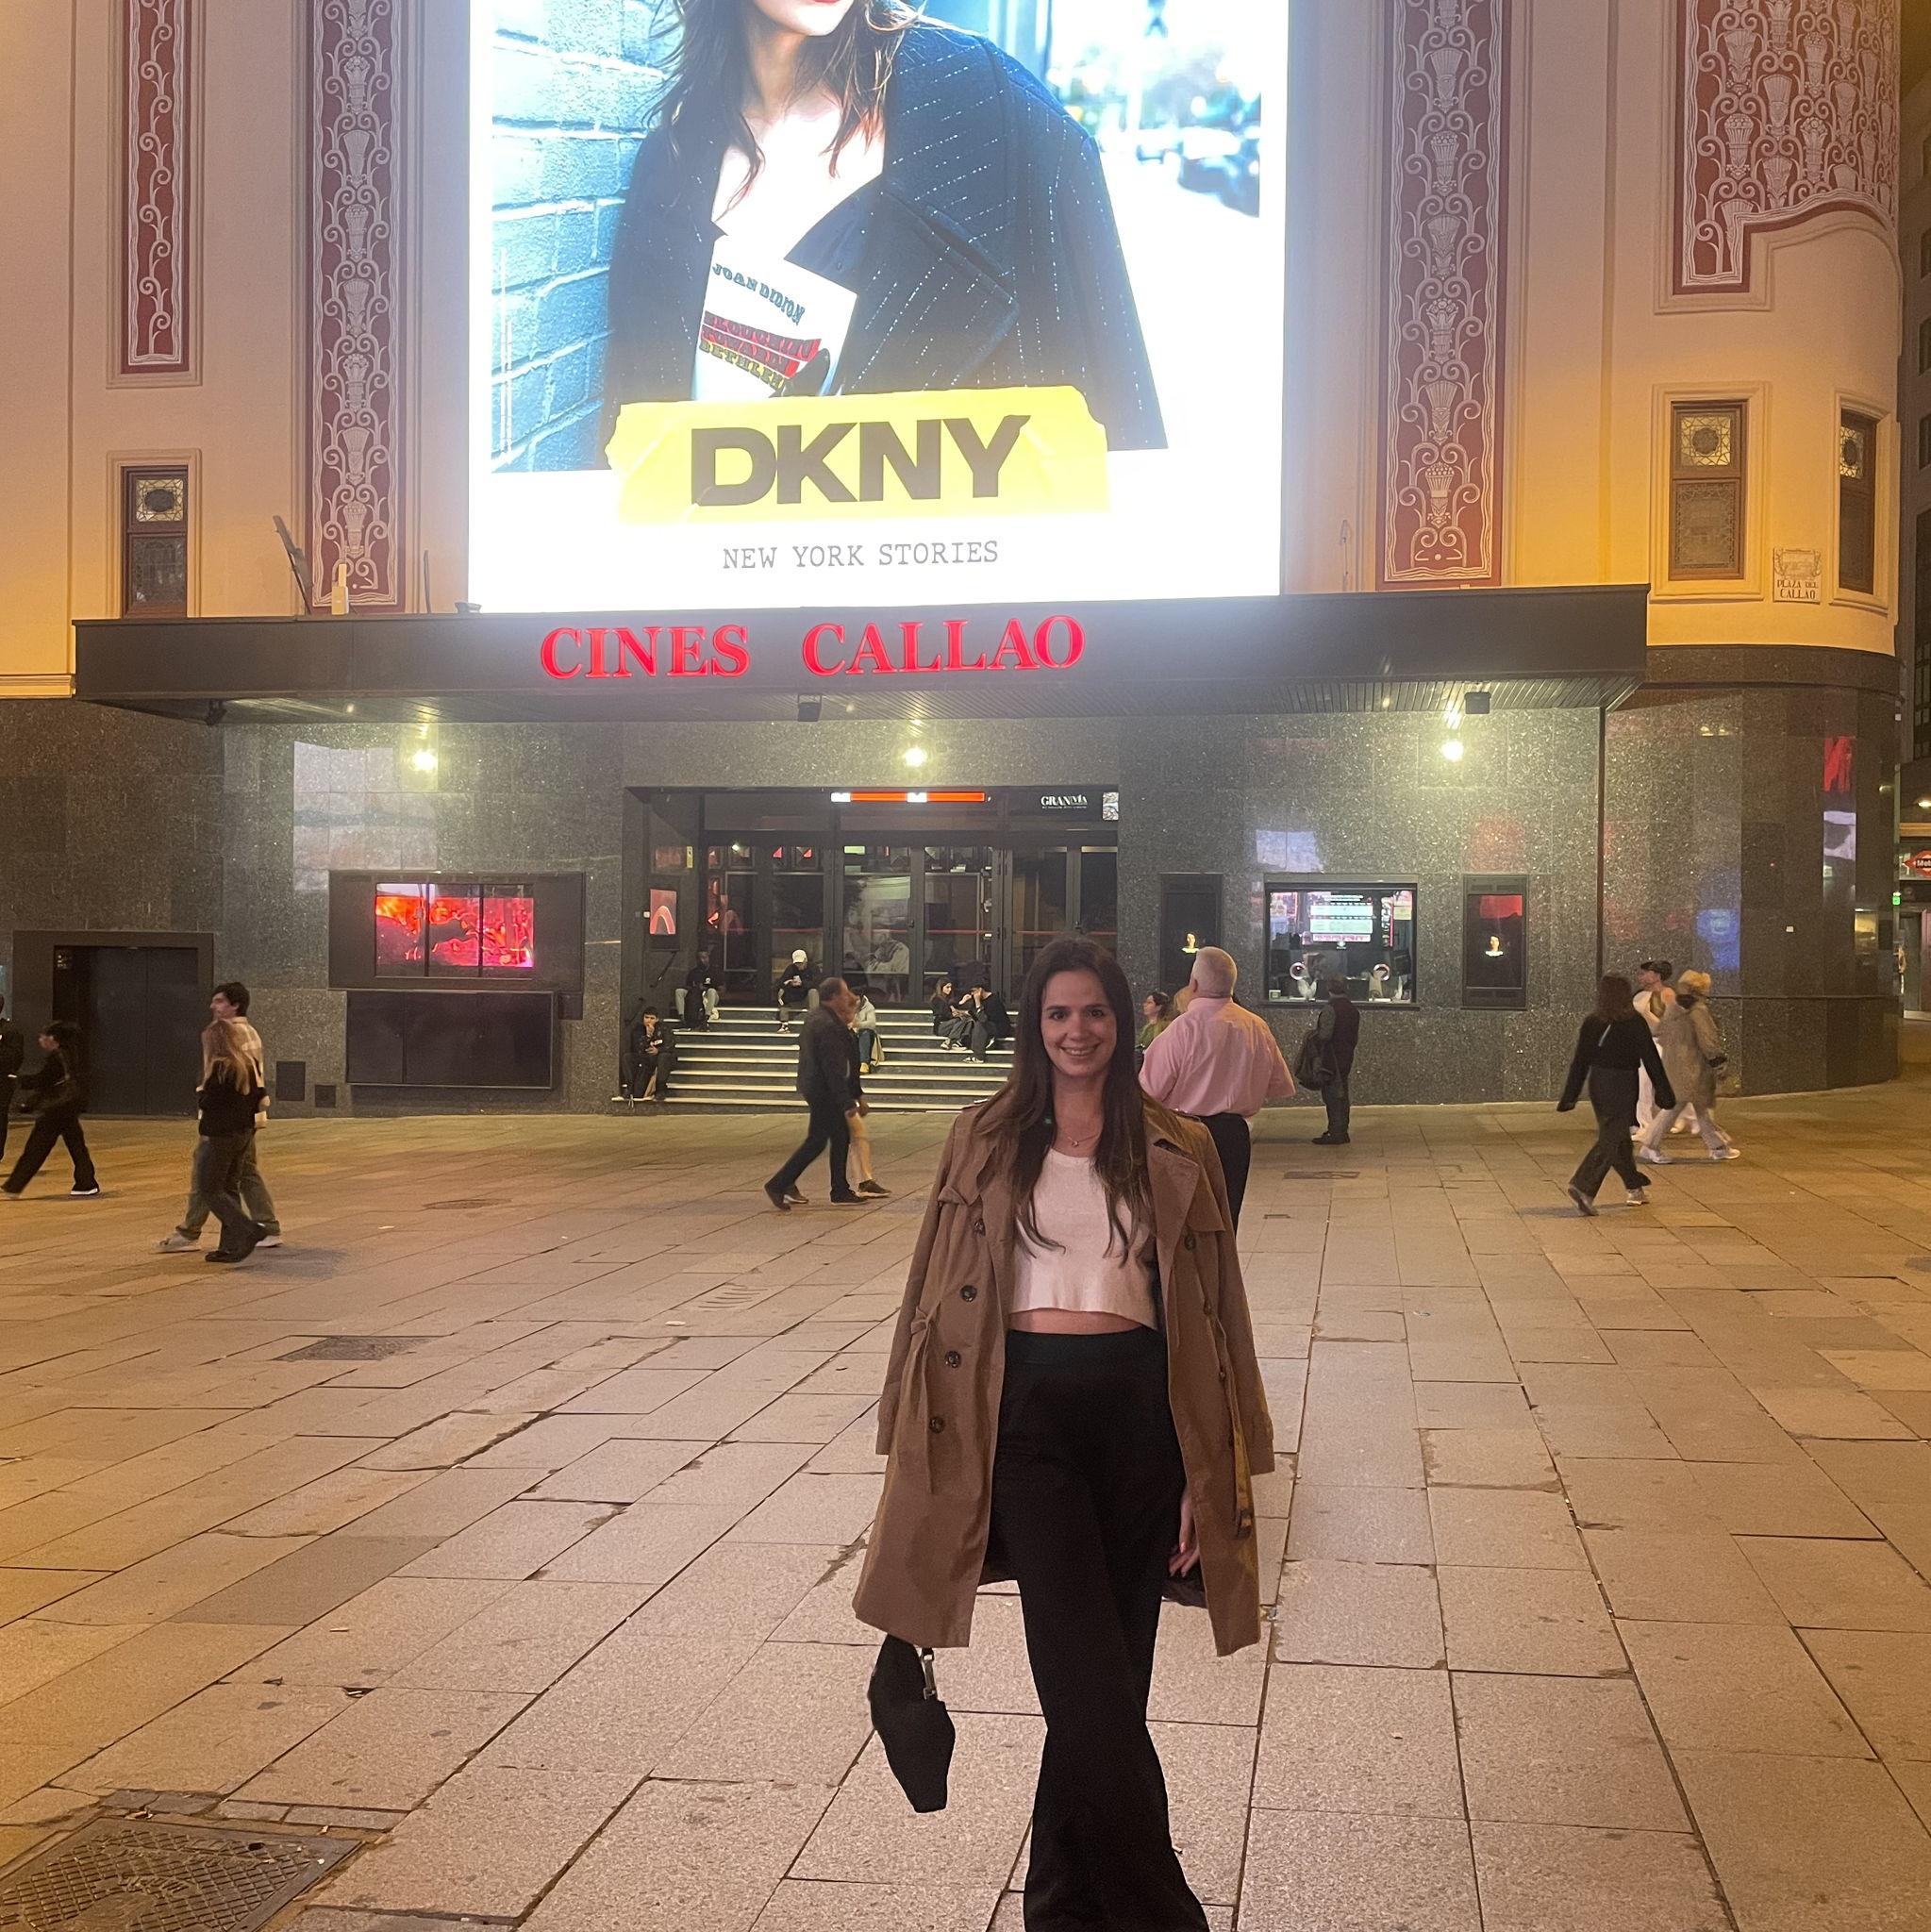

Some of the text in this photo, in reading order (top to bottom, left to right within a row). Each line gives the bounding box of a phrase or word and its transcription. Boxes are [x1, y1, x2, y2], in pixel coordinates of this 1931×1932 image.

[712, 263, 806, 325] JOAN DIDION
[691, 415, 1031, 507] DKNY
[723, 541, 998, 569] NEW YORK STORIES
[1777, 579, 1819, 590] PLAZA DEL
[1780, 588, 1816, 600] CALLAO
[541, 615, 1086, 679] CINES CALLAO
[1916, 859, 1931, 868] Met
